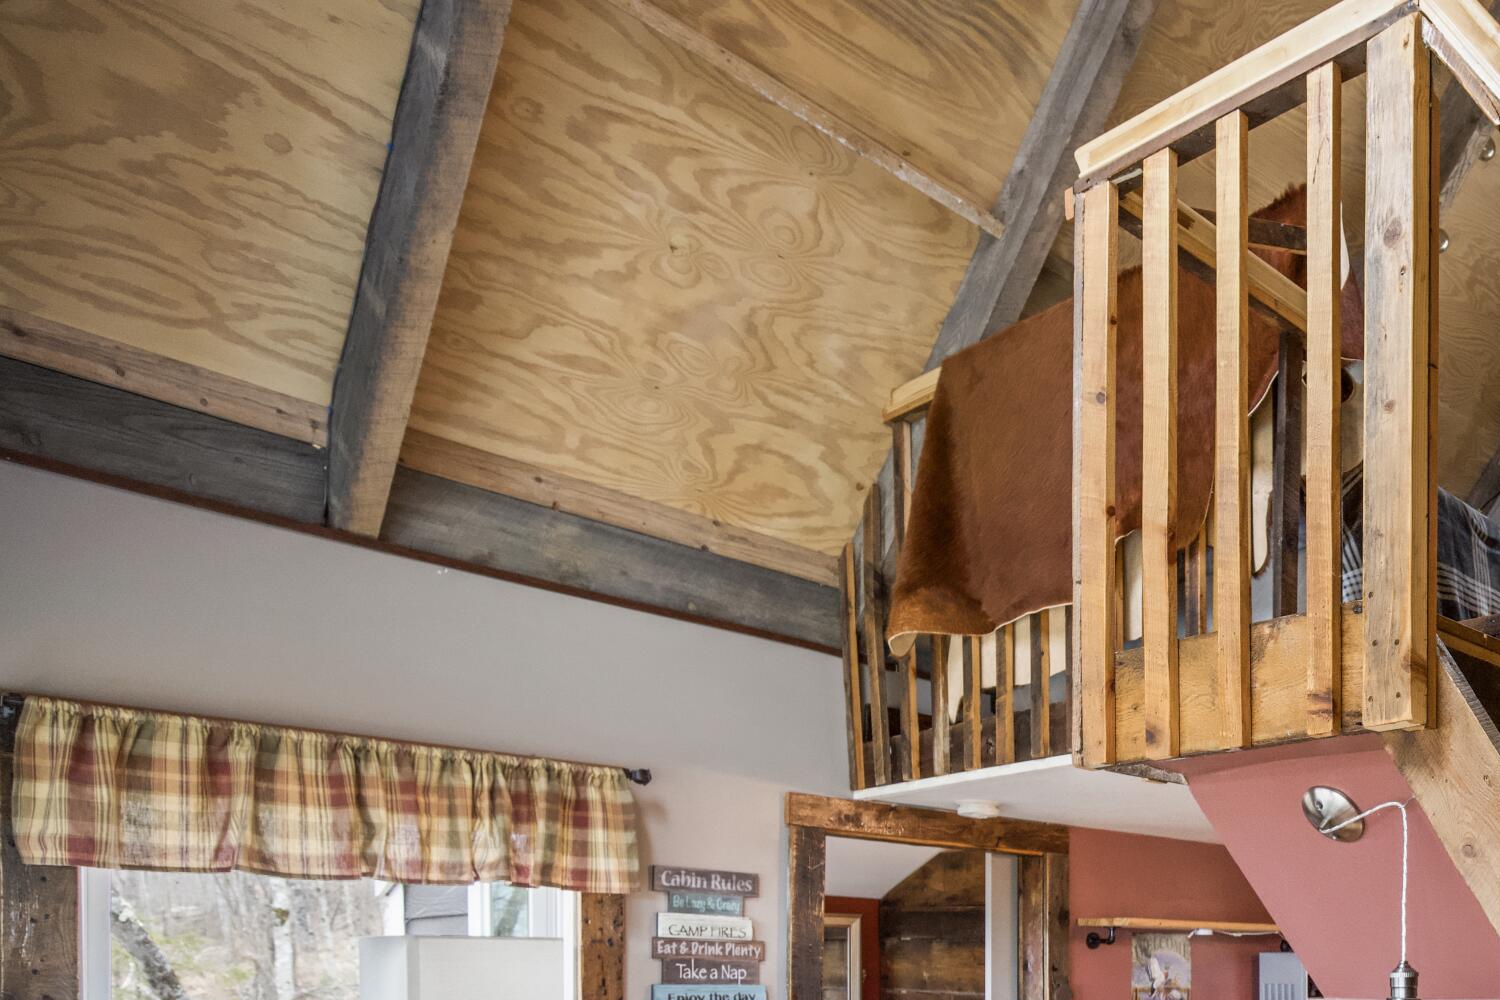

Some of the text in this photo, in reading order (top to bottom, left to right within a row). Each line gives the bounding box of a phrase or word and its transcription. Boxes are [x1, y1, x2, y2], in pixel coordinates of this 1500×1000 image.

[661, 870, 753, 892] Cabin Rules
[707, 896, 716, 910] &
[657, 940, 761, 959] Eat & Drink Plenty
[675, 958, 747, 985] Take a Nap
